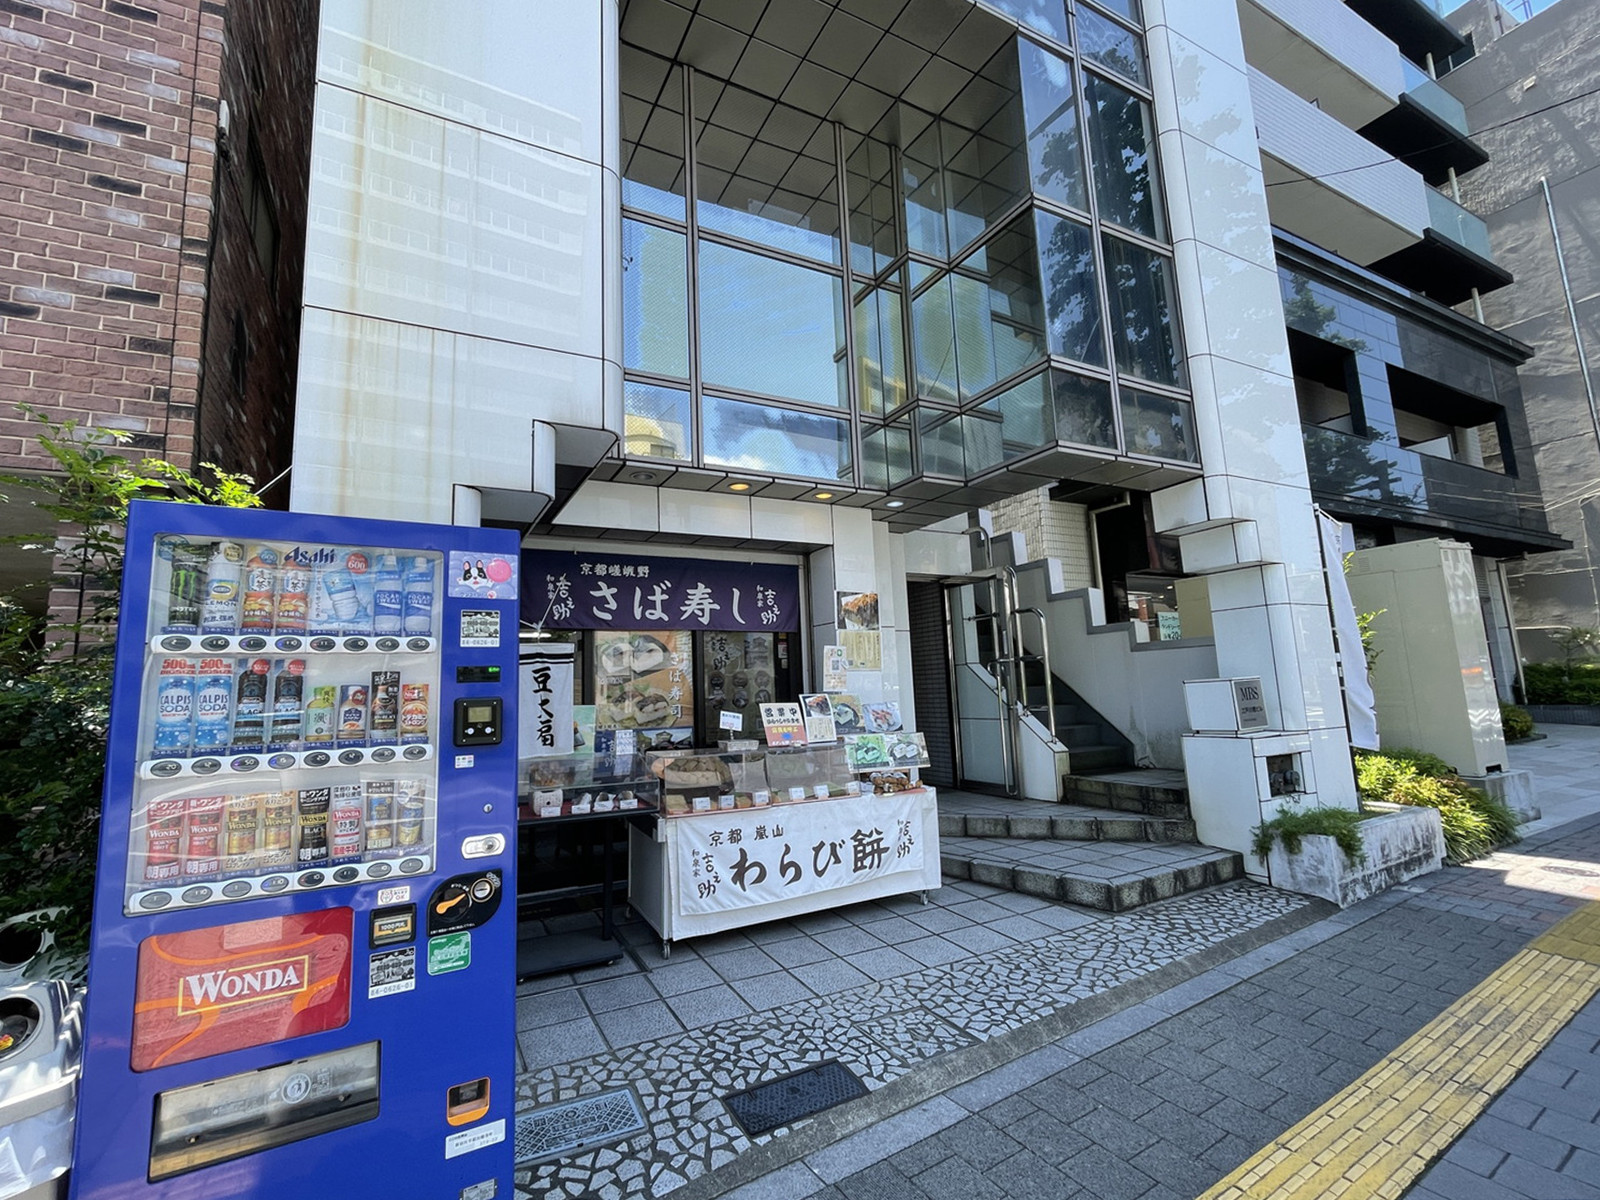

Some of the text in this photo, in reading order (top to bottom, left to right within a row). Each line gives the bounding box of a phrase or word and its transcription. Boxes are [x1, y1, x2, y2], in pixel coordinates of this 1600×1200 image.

[283, 546, 335, 564] Asahi
[347, 561, 365, 570] 600
[580, 562, 650, 578] 京都嵯峨野
[589, 579, 746, 626] さば寿し
[159, 704, 190, 713] SODA
[198, 703, 228, 712] SODA
[301, 815, 326, 824] WONDA
[149, 829, 180, 839] WONDA
[190, 825, 219, 834] WONDA
[708, 824, 784, 847] 京都 嵐山
[729, 827, 890, 892] わらび餅
[186, 964, 300, 1006] WONDA
